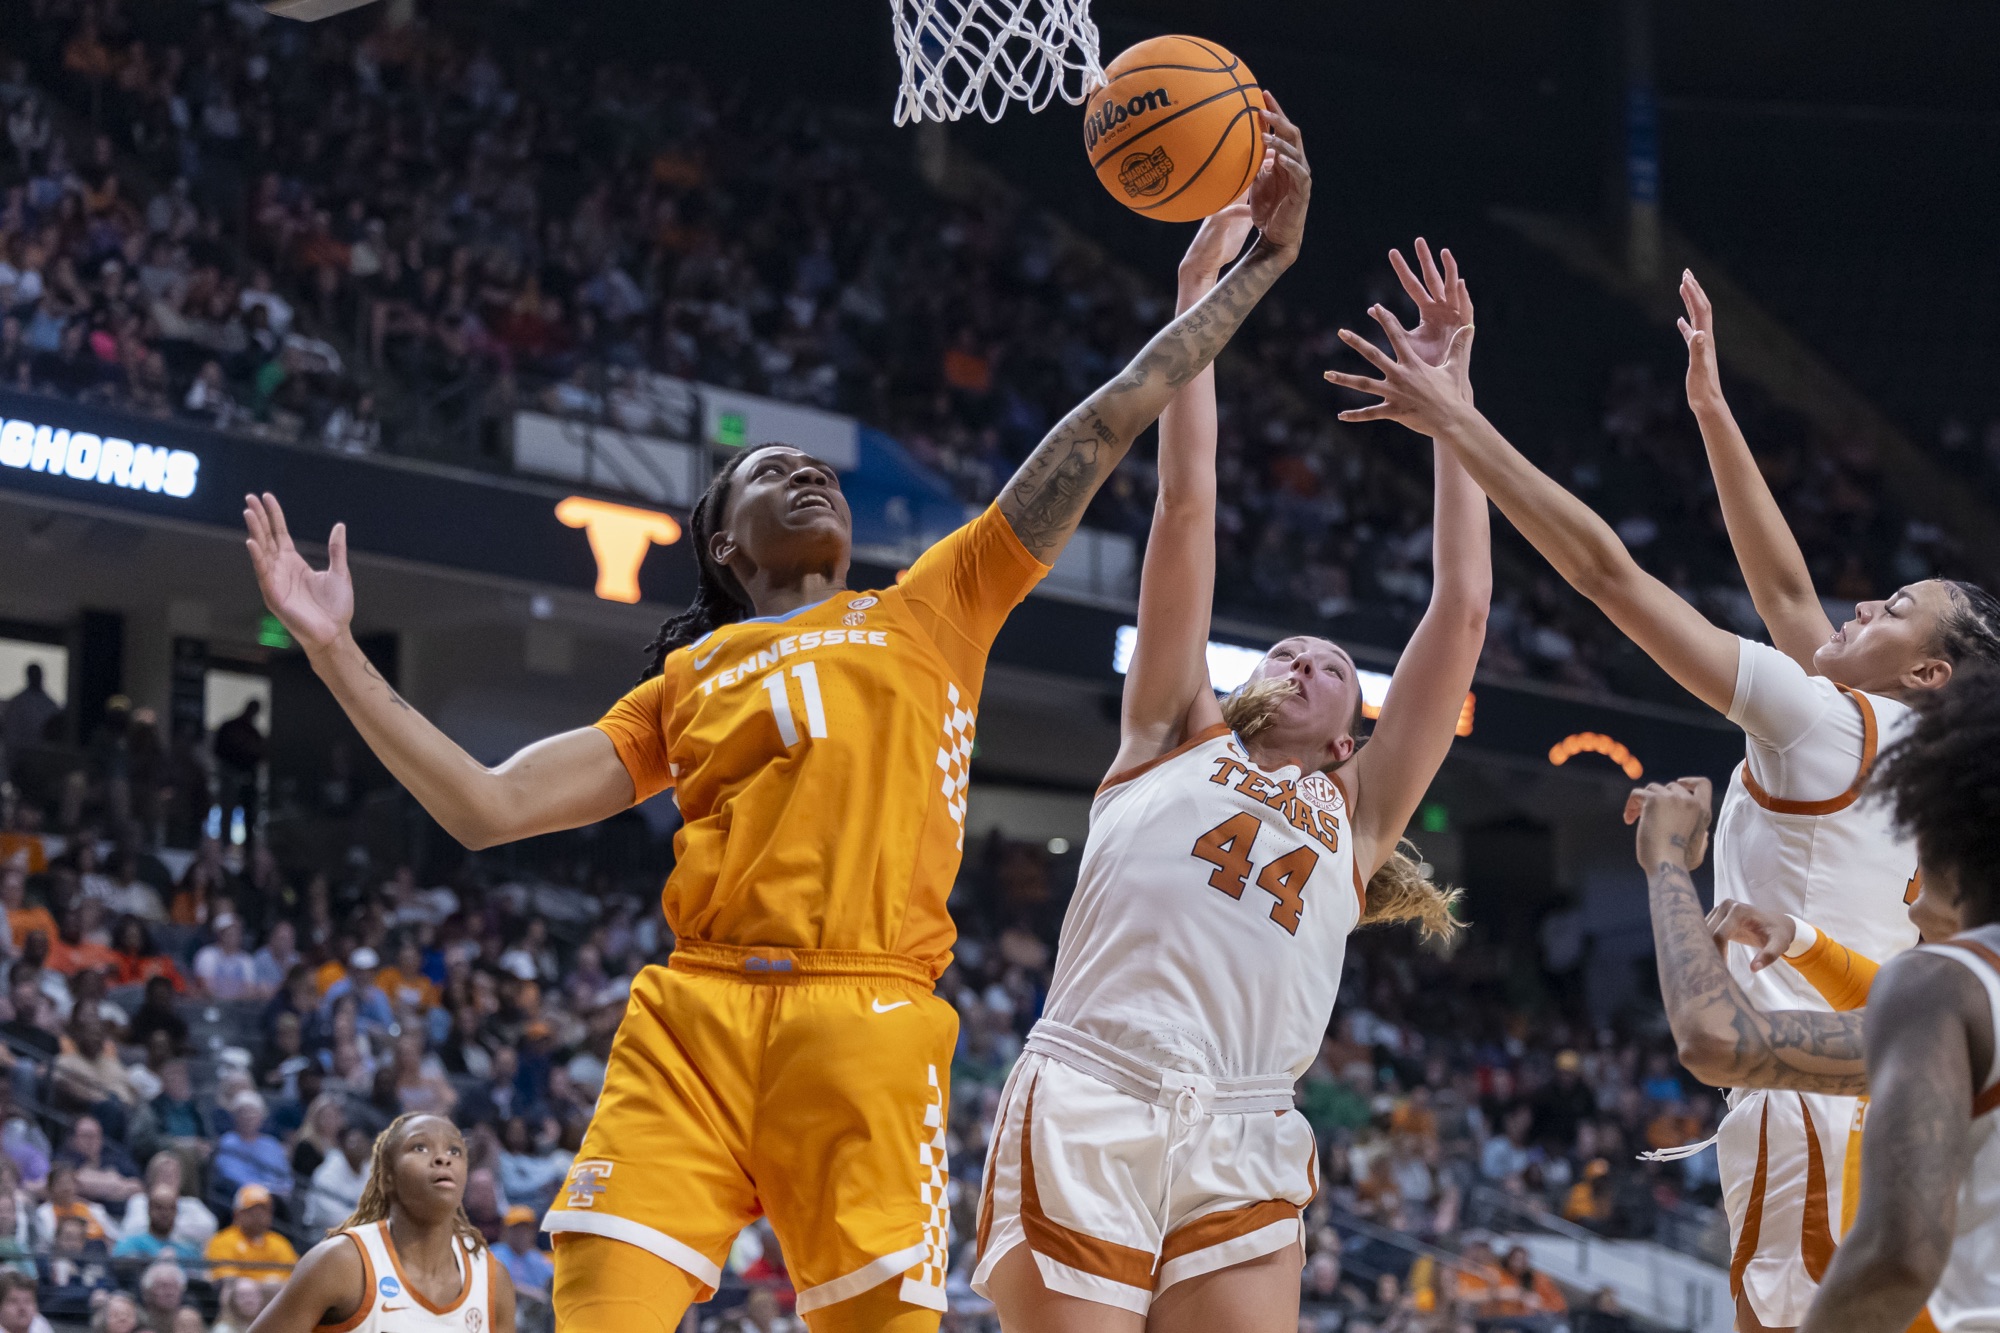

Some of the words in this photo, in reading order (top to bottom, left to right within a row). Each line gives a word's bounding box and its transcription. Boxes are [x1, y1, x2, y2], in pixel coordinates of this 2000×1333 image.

[1084, 87, 1171, 153] Wilson
[1125, 158, 1153, 181] MARCH
[1134, 156, 1174, 190] MADNESS
[0, 416, 200, 499] GHORNS
[553, 495, 682, 605] T
[842, 612, 865, 627] SEC
[698, 629, 888, 697] TENNESSEE
[762, 661, 828, 749] 11
[1208, 757, 1340, 854] TEXAS
[1303, 777, 1335, 802] SEC
[1191, 811, 1319, 936] 44
